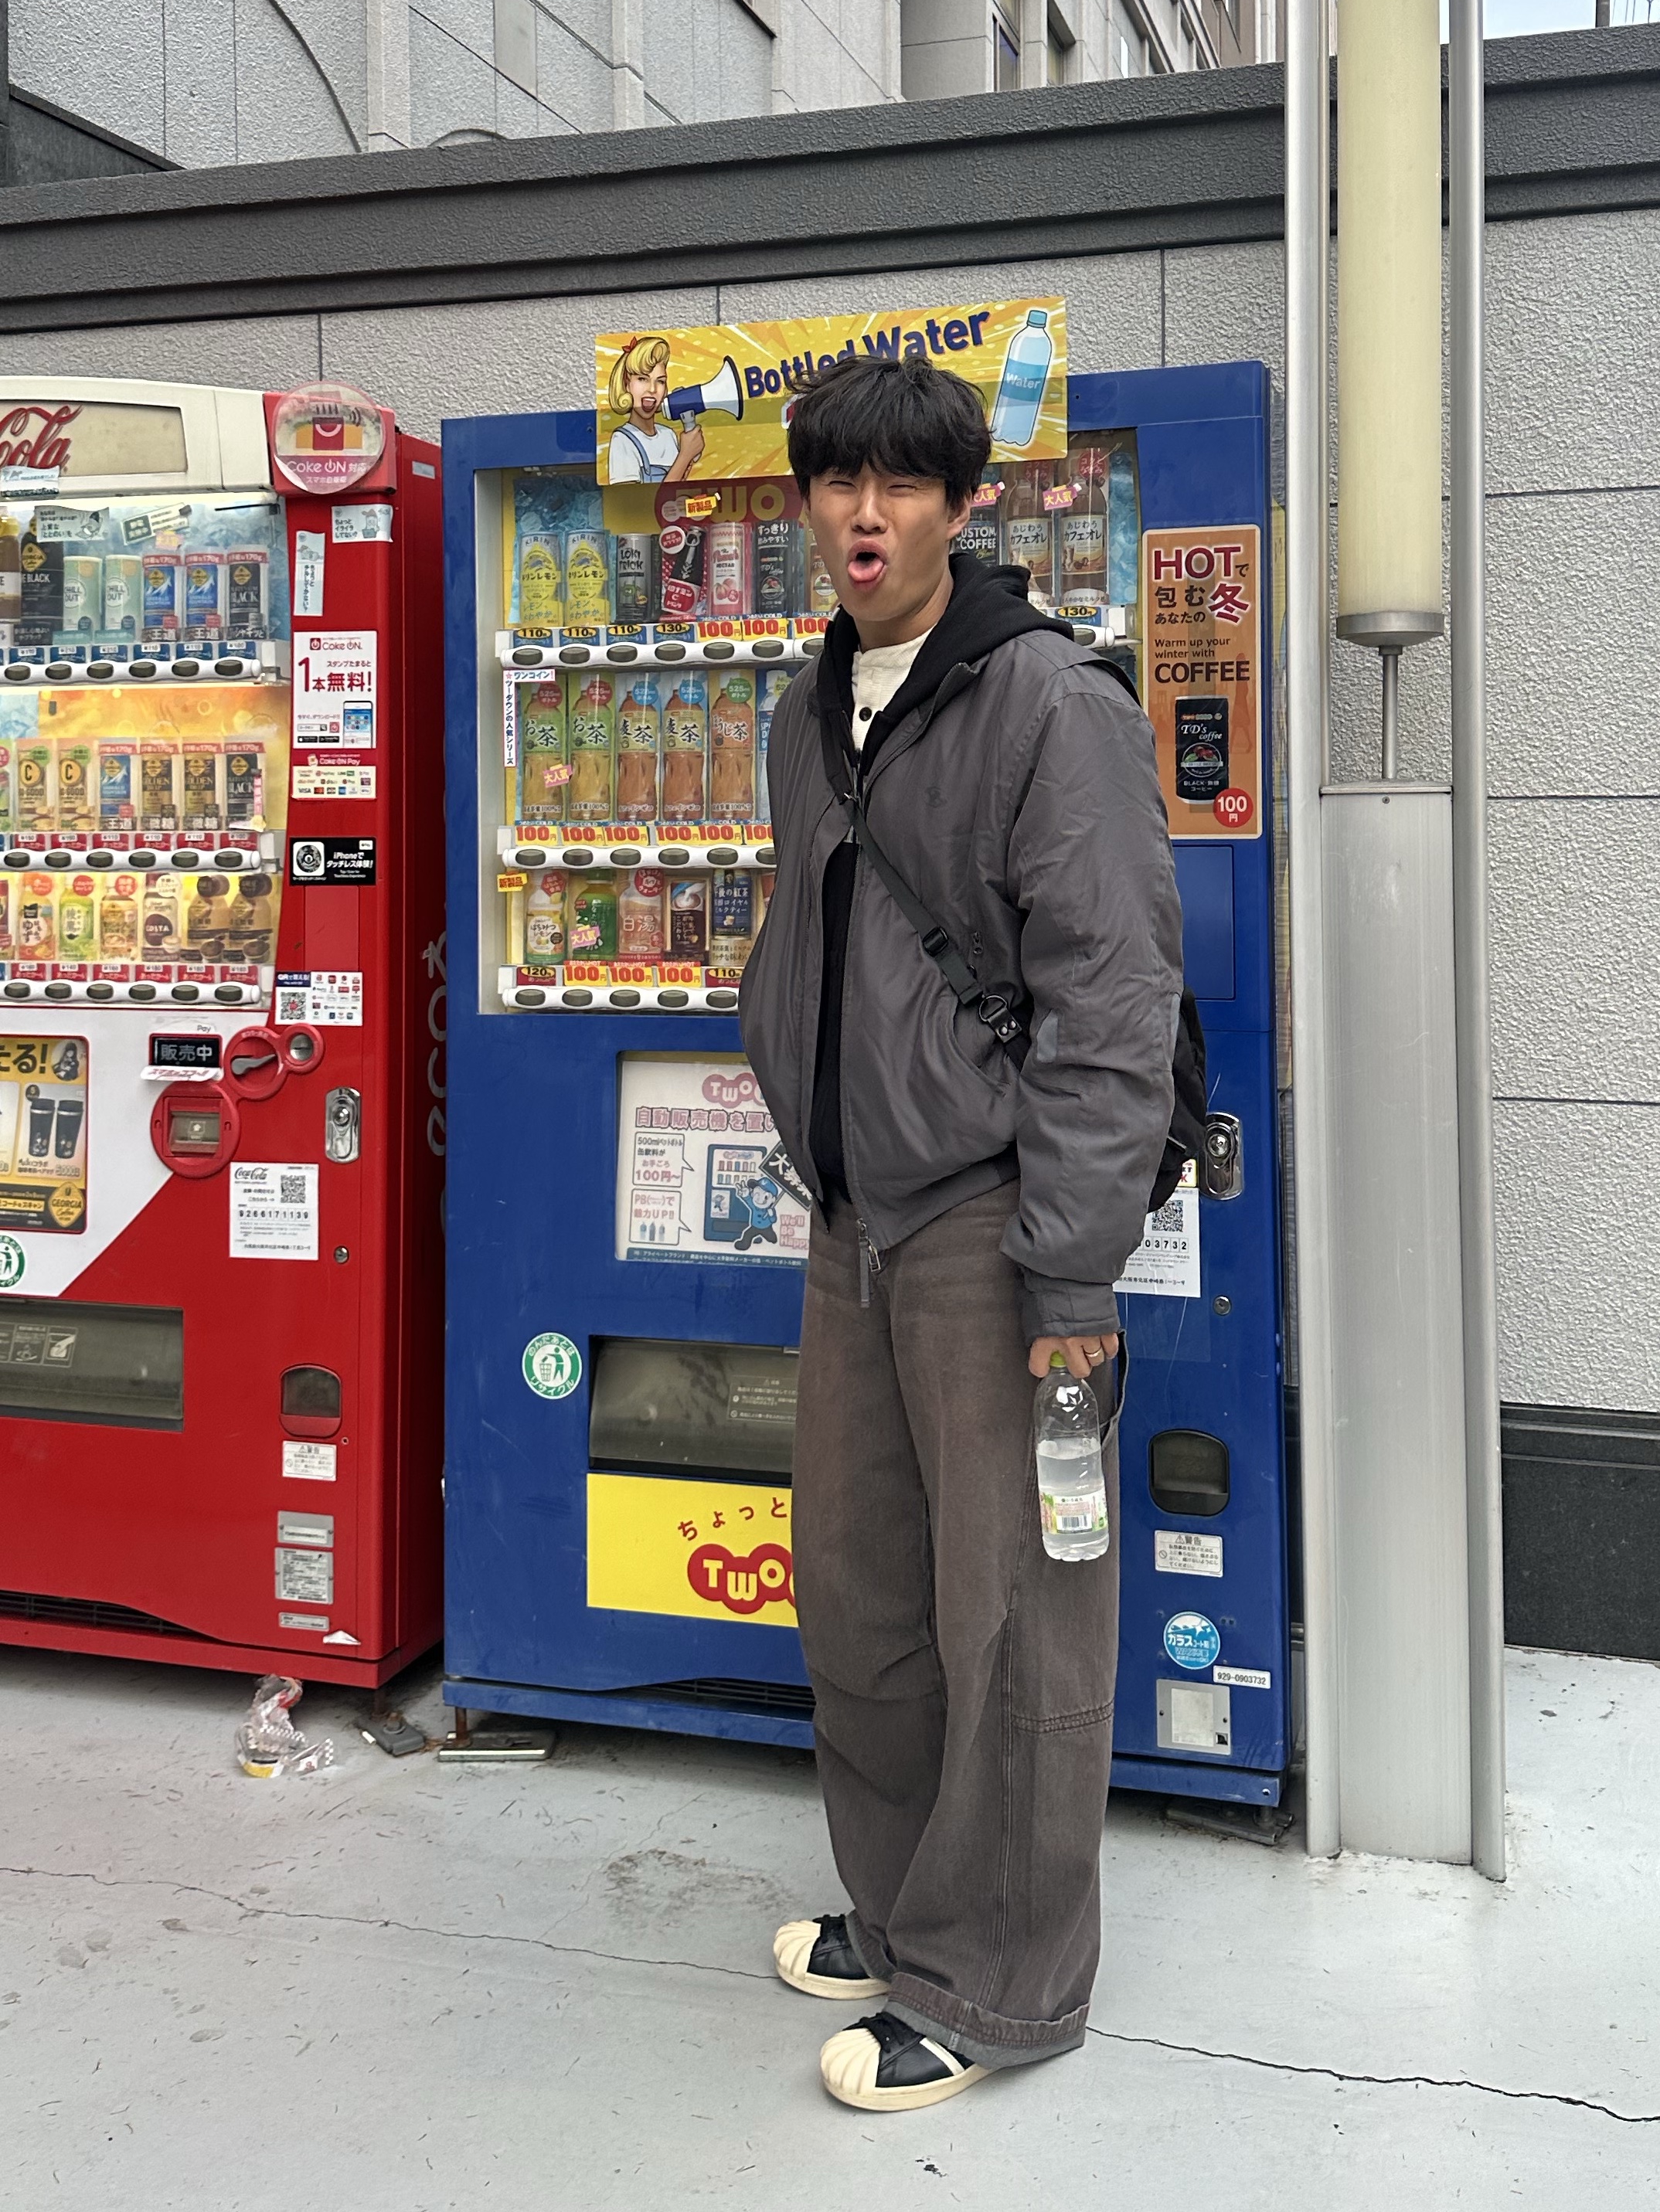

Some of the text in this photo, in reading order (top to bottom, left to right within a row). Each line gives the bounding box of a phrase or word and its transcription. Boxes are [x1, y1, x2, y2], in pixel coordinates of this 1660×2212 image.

[862, 311, 991, 360] Water
[1005, 372, 1041, 389] Water
[287, 460, 321, 473] Coke
[325, 459, 347, 473] ON
[757, 524, 789, 535] すっきり
[1012, 523, 1043, 532] あじわう
[1066, 520, 1097, 530] あじわう
[525, 536, 550, 545] KIRIN
[571, 534, 597, 544] KIRIN
[1009, 531, 1048, 545] カフェオレ
[1063, 529, 1102, 542] カフェオレ
[959, 538, 997, 549] COFFEE
[1155, 583, 1250, 624] 包む 冬
[1155, 611, 1206, 625] あなたの
[322, 641, 345, 651] Coke
[1154, 637, 1231, 648] Warm up your
[1155, 648, 1215, 658] winter with
[1155, 660, 1250, 684] COFFEE
[525, 719, 559, 748] お茶
[573, 716, 607, 746] お茶
[619, 719, 653, 744] 麦茶
[665, 716, 700, 743] 麦茶
[1180, 724, 1223, 742] TD's coffee
[543, 768, 570, 783] 大人気
[1217, 796, 1247, 813] 100
[1229, 813, 1238, 823] 円
[623, 916, 655, 933] 白湯
[196, 1024, 212, 1034] Pay
[160, 1044, 213, 1062] 販売中
[709, 1080, 765, 1104] TWO
[780, 1226, 795, 1237] Be
[1139, 1239, 1188, 1250] 03732
[529, 1375, 575, 1396] リサイクル
[677, 1496, 788, 1541] ちょっと
[702, 1558, 794, 1602] TWO
